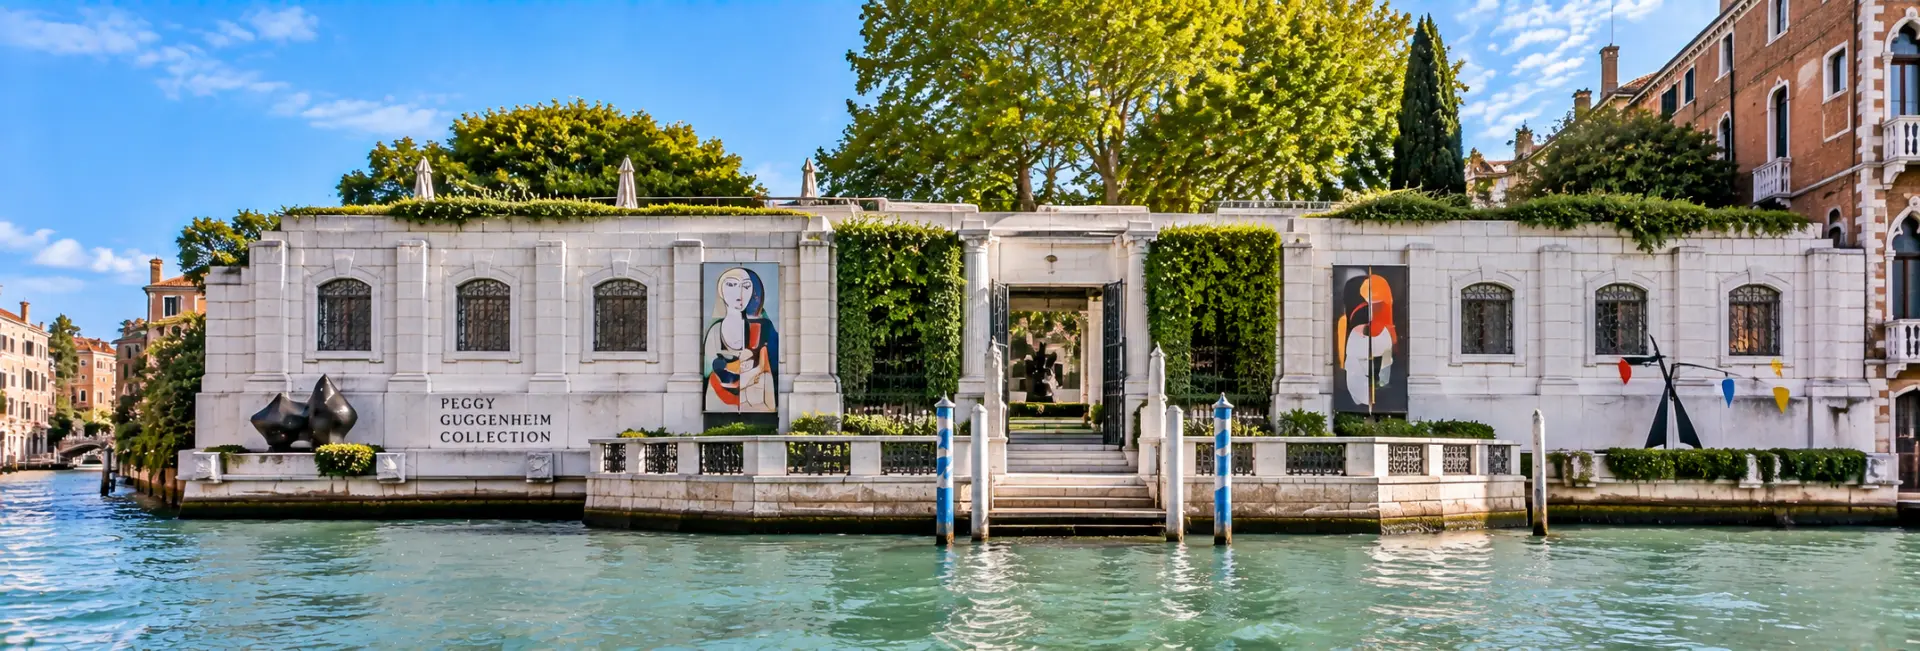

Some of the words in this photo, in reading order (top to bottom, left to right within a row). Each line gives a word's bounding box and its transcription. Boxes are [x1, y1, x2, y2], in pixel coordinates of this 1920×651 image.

[441, 397, 496, 410] PEGGY
[440, 414, 551, 426] GUGGENHEIM
[440, 431, 551, 443] COLLECTION
